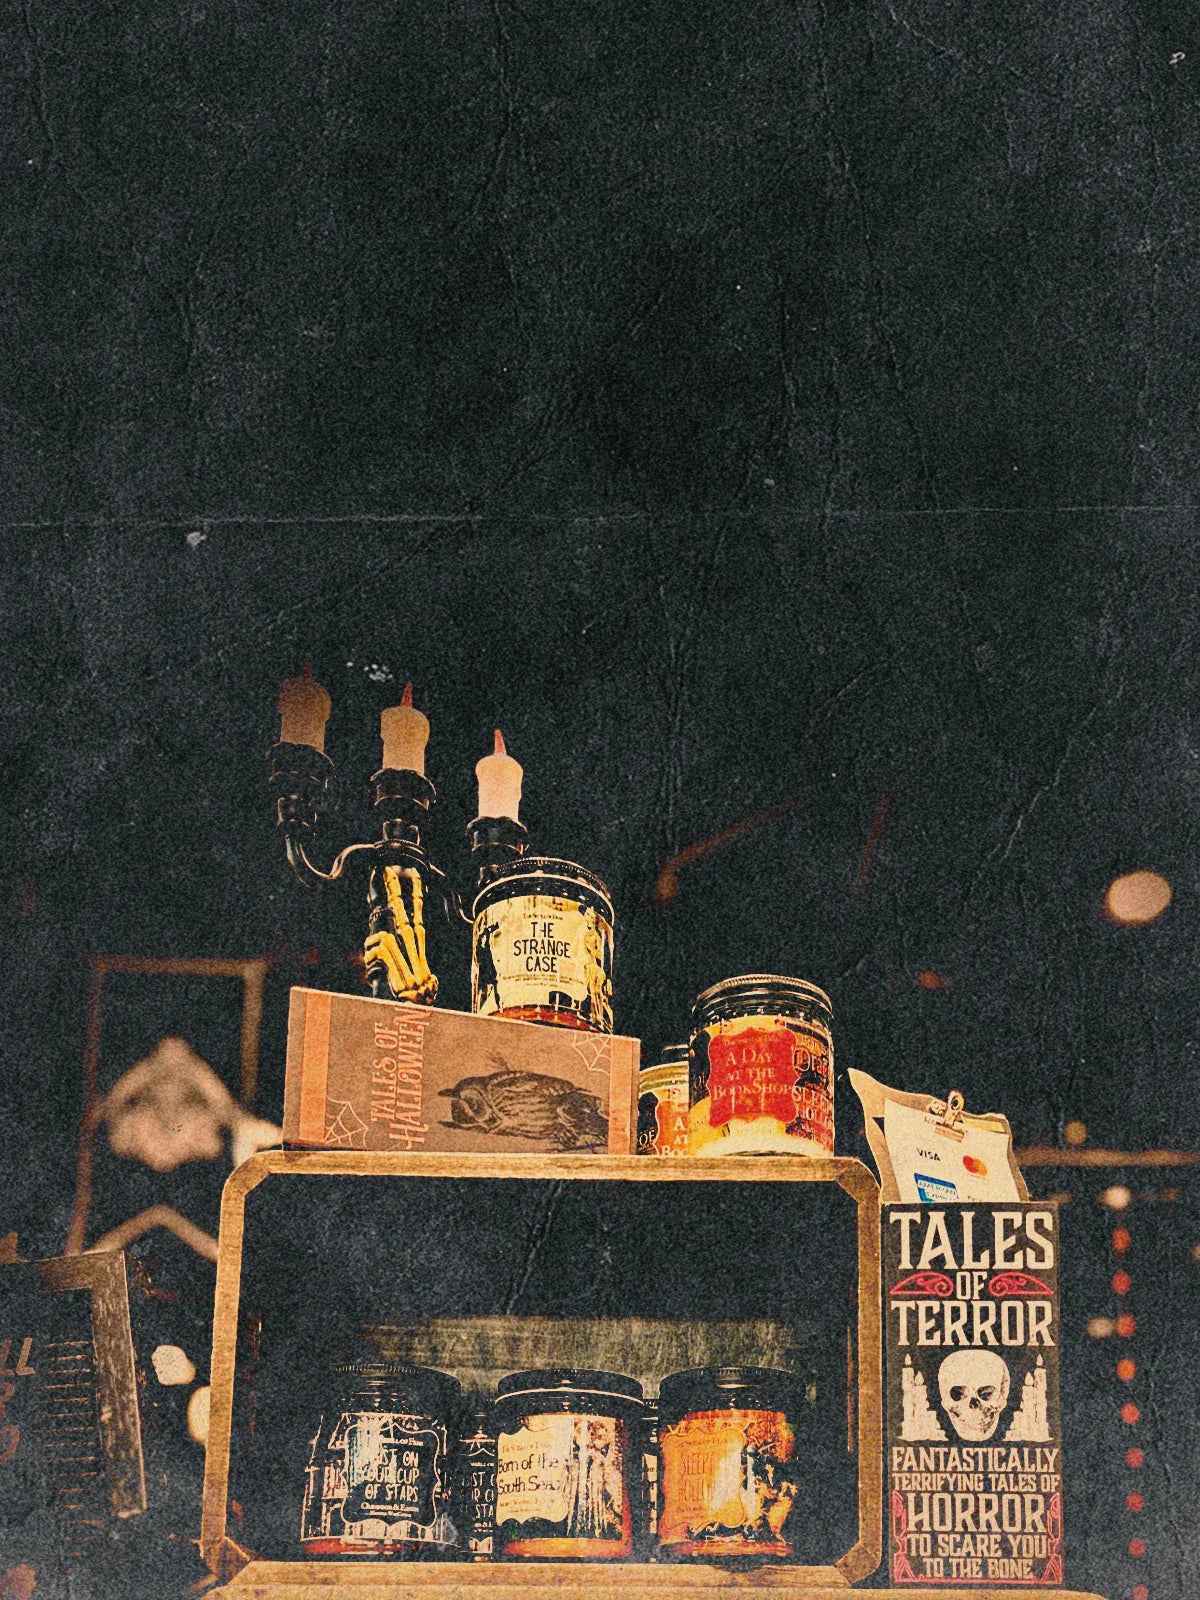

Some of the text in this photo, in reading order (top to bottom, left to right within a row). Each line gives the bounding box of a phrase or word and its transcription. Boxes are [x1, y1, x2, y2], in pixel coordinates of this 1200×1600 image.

[530, 921, 555, 938] THE
[513, 939, 571, 959] STRANGE
[525, 956, 558, 973] CASE
[726, 1051, 737, 1067] A
[742, 1047, 774, 1064] DAY
[371, 1022, 399, 1122] TALES OF
[388, 1006, 433, 1150] HALLOWEEN
[727, 1067, 776, 1082] AT THE
[915, 1147, 941, 1162] VISA
[889, 1211, 1054, 1270] TALES
[955, 1271, 988, 1300] OF
[890, 1300, 1057, 1347] TERROR
[403, 1450, 419, 1468] ON
[521, 1453, 534, 1470] of
[891, 1446, 1060, 1473] FANTASTICALLY
[397, 1467, 420, 1485] CUP
[892, 1472, 1061, 1492] TERRIFYING TALES OF
[365, 1483, 419, 1502] OF STARS
[906, 1492, 1049, 1533] HORROR
[907, 1533, 1049, 1559] TO SCARE YOU
[923, 1557, 1034, 1579] TO THE BONE
